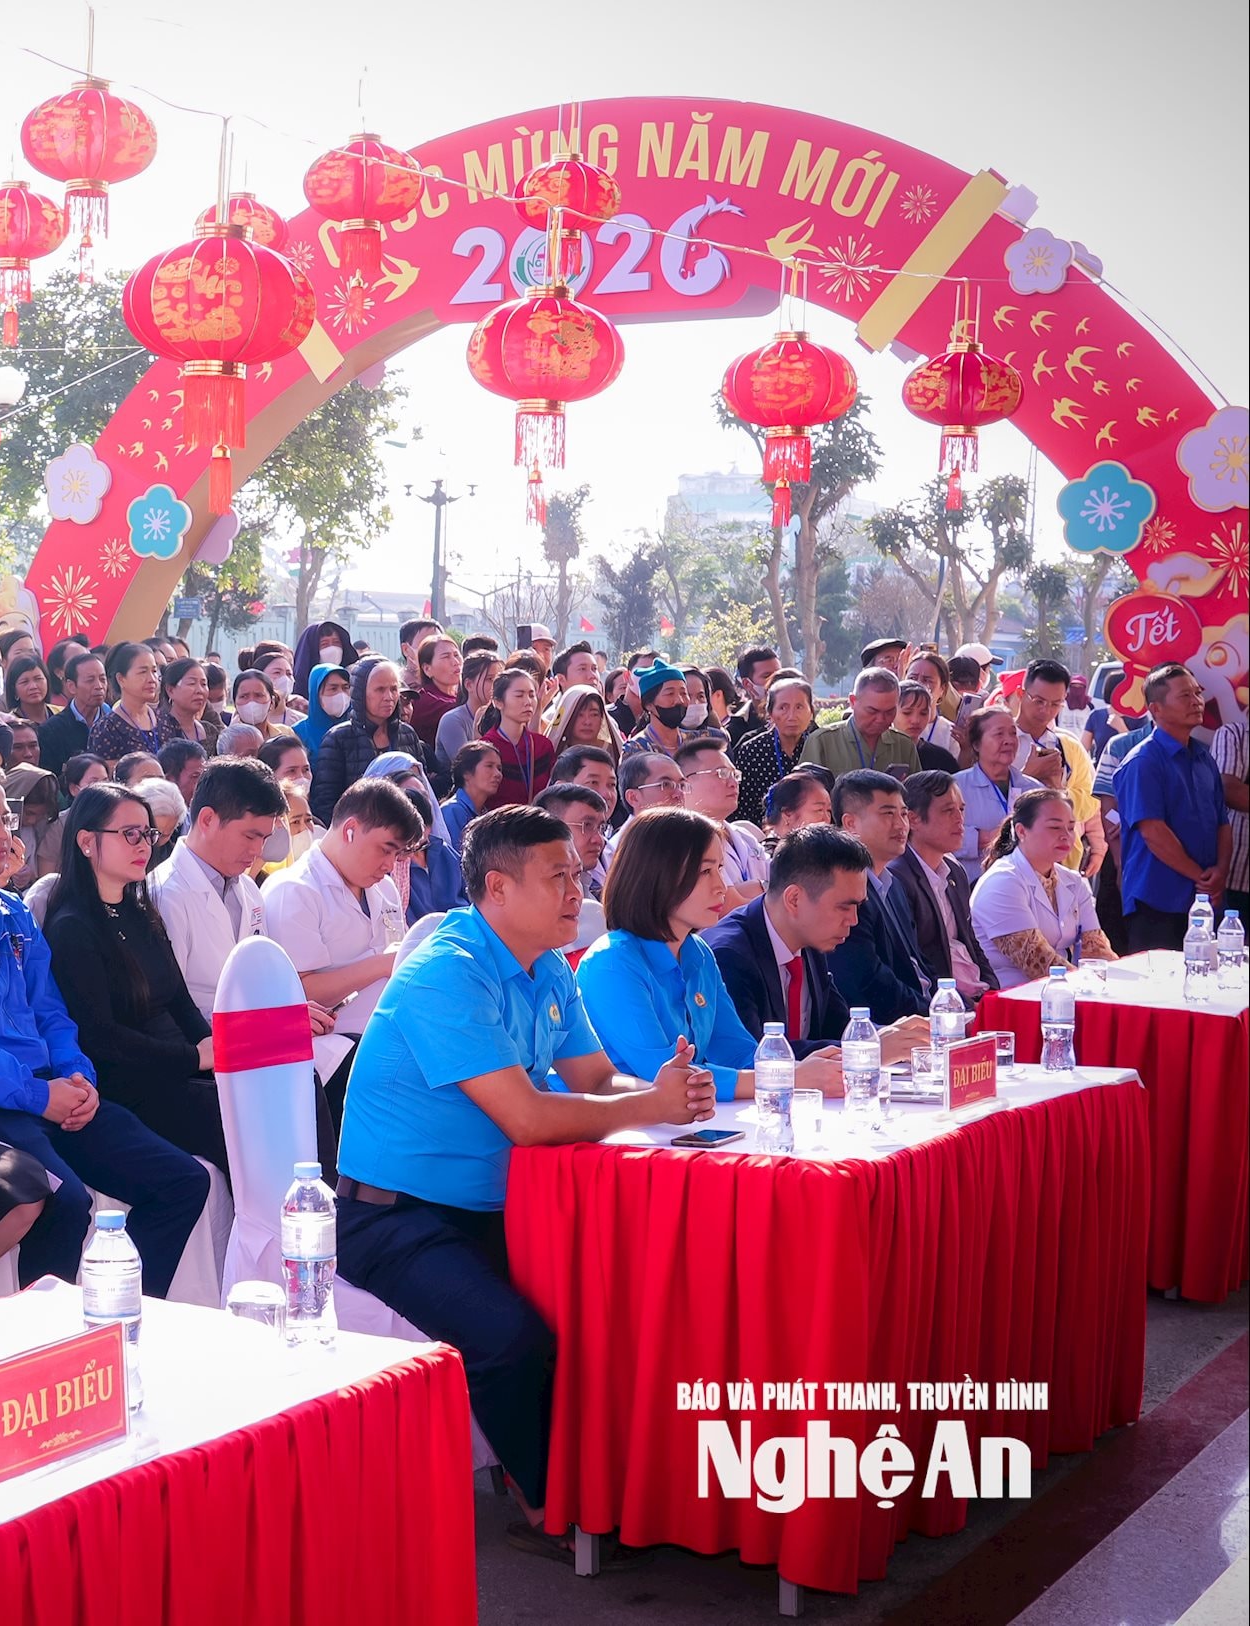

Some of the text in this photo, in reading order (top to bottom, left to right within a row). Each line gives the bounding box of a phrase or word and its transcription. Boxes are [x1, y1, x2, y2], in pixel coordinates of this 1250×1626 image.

[637, 111, 770, 189] NĂM
[778, 139, 901, 229] MỚI
[1125, 605, 1181, 652] Tết
[953, 1056, 993, 1091] ĐẠI BIỂU
[1, 1359, 113, 1437] ĐẠI BIỂU
